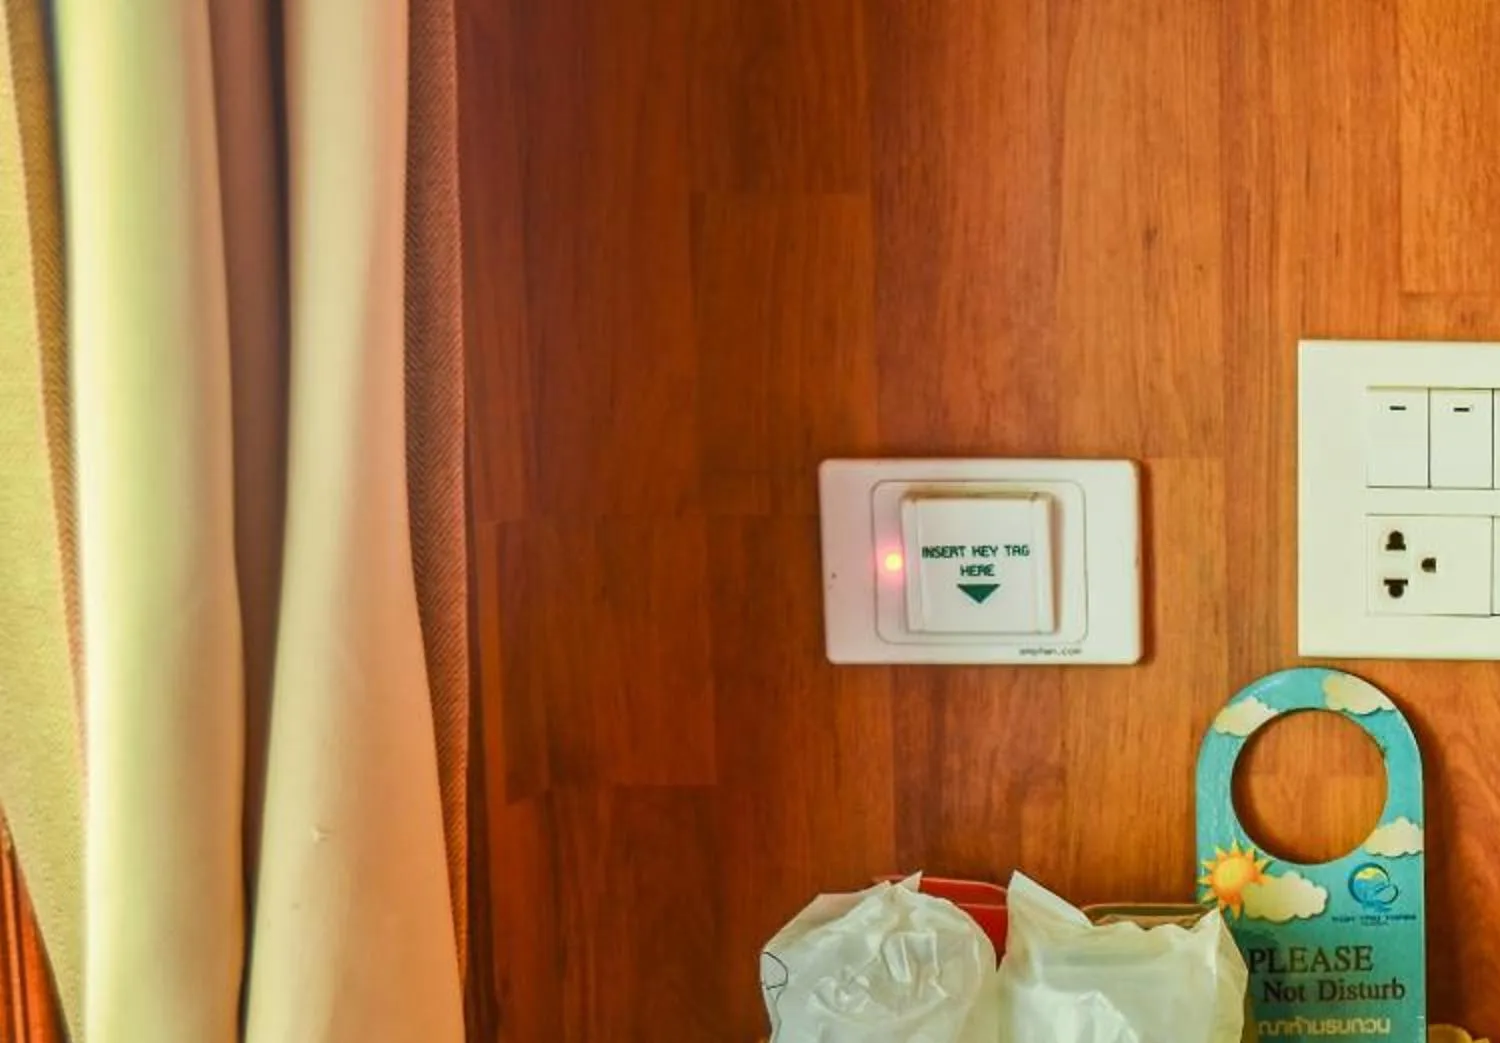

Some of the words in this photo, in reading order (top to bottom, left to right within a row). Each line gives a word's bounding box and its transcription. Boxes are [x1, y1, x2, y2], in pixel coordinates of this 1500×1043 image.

[922, 545, 966, 558] INSERT
[971, 545, 999, 557] KEY
[1004, 544, 1030, 557] TAG
[960, 564, 995, 577] HERE
[1249, 945, 1374, 974] PLEASE
[1263, 980, 1306, 1003] Not
[1318, 976, 1406, 1003] Disturb
